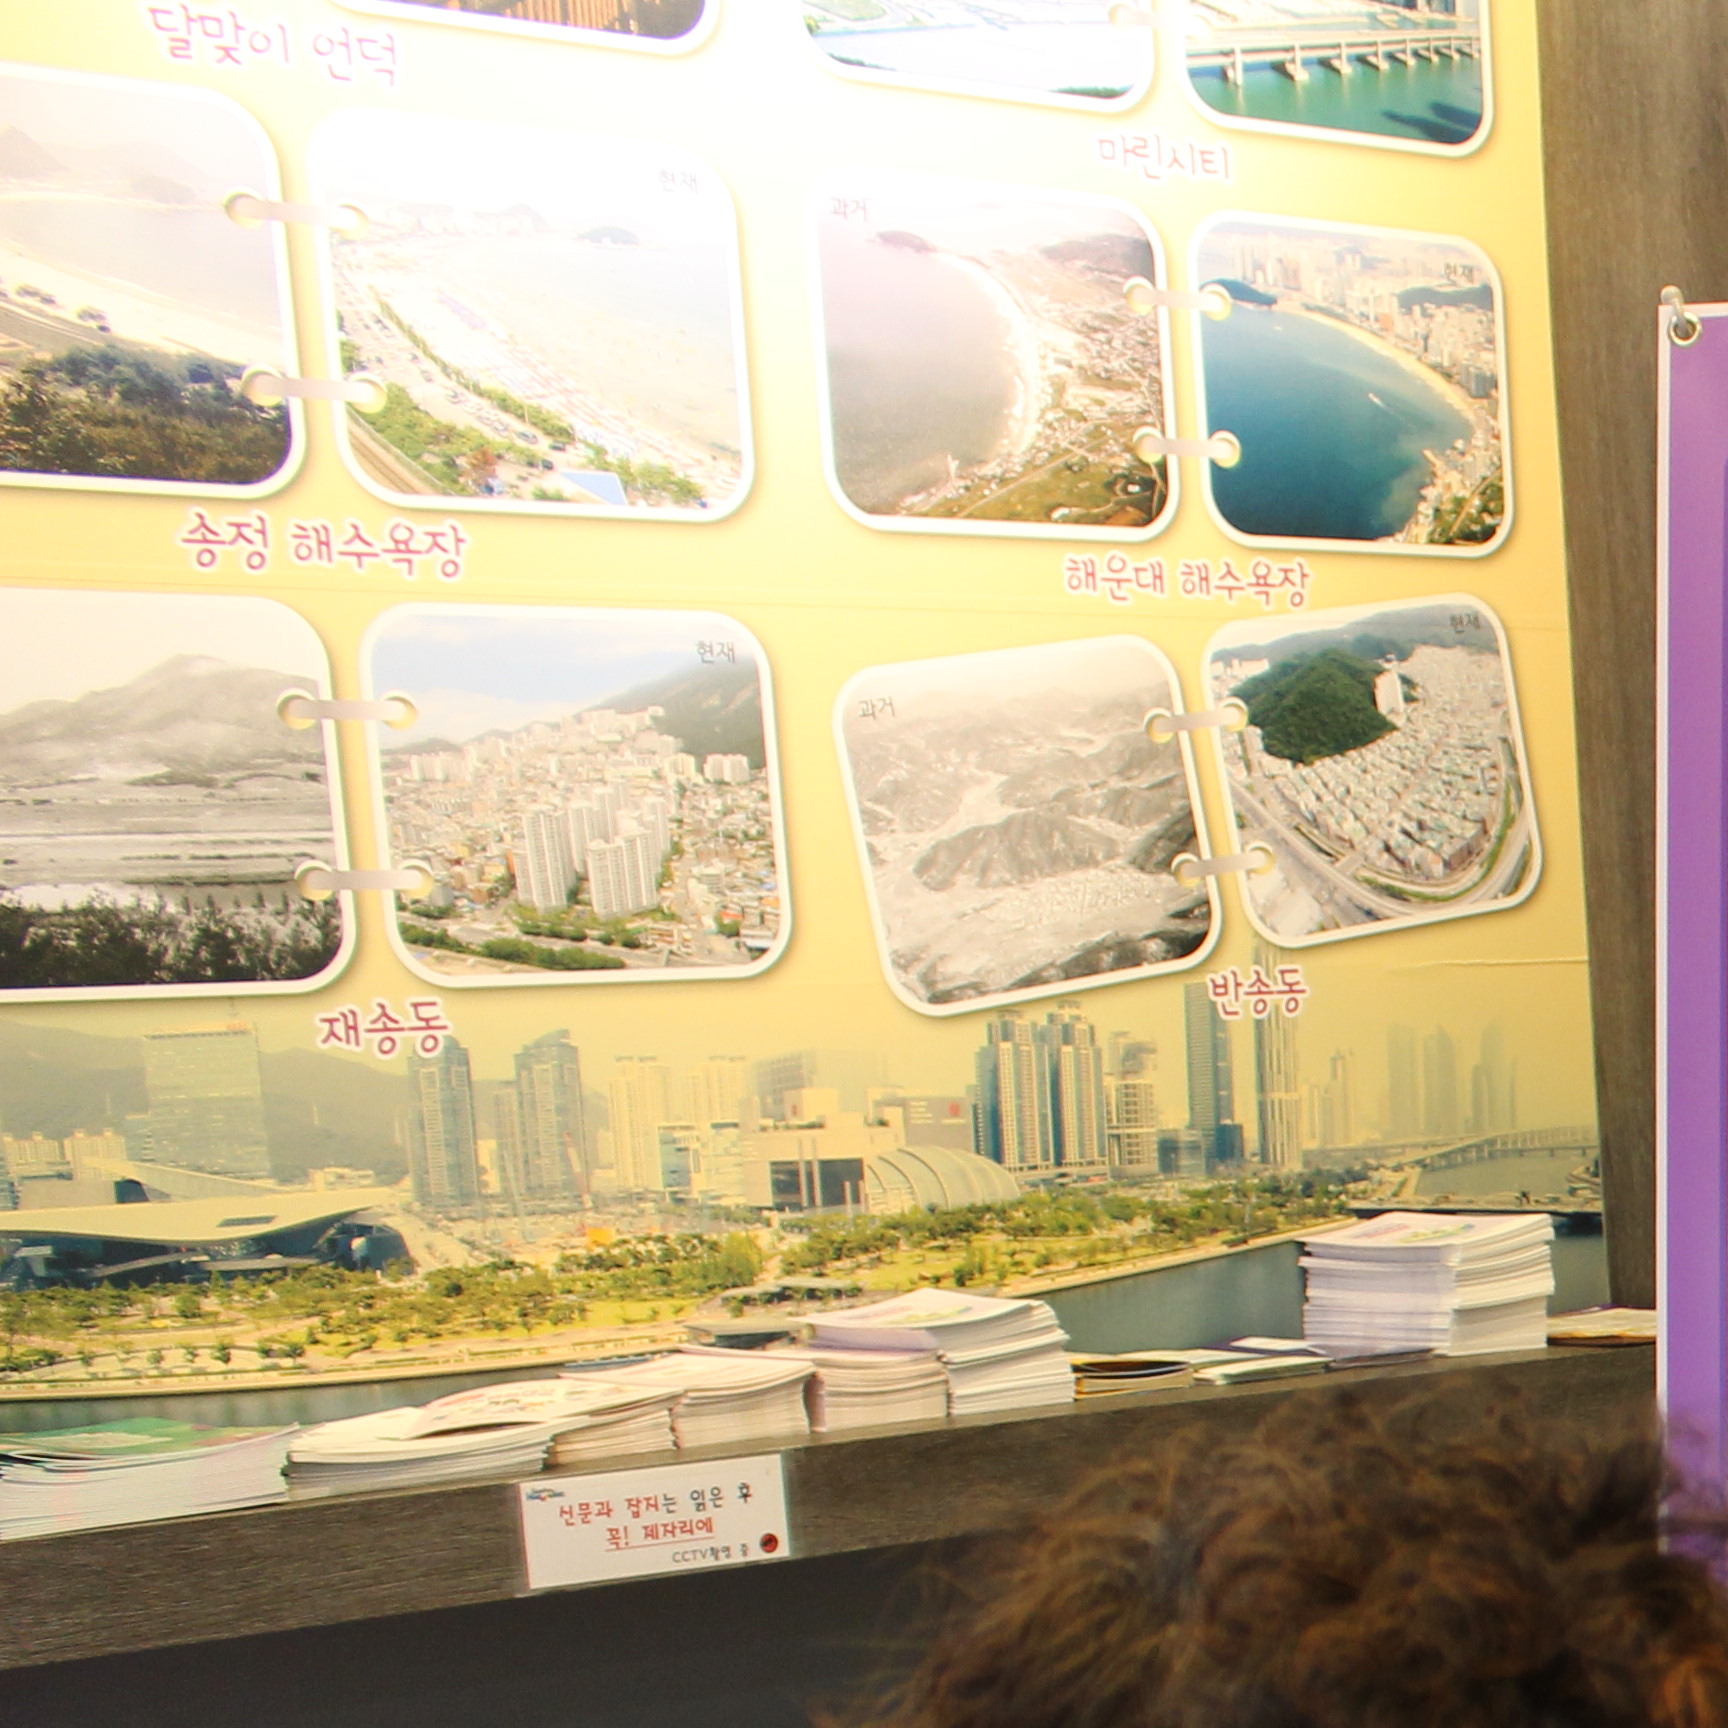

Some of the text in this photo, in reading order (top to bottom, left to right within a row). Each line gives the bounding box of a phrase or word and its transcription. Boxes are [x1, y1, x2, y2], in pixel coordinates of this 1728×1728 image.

[147, 2, 396, 87] 달맞이 언덕
[1098, 132, 1231, 181] 마린시티
[658, 168, 698, 195] 현재
[181, 512, 466, 578] 송정 해수욕장
[1065, 553, 1310, 609] 해운대 해수욕장
[695, 640, 736, 664] 현재
[858, 696, 896, 720] 과거
[1210, 968, 1306, 1016] 반송동
[319, 1001, 449, 1055] 재송동
[559, 1482, 753, 1527] 신문과 잡지는 읽은 후
[605, 1516, 714, 1550] 꼭! 제자리에
